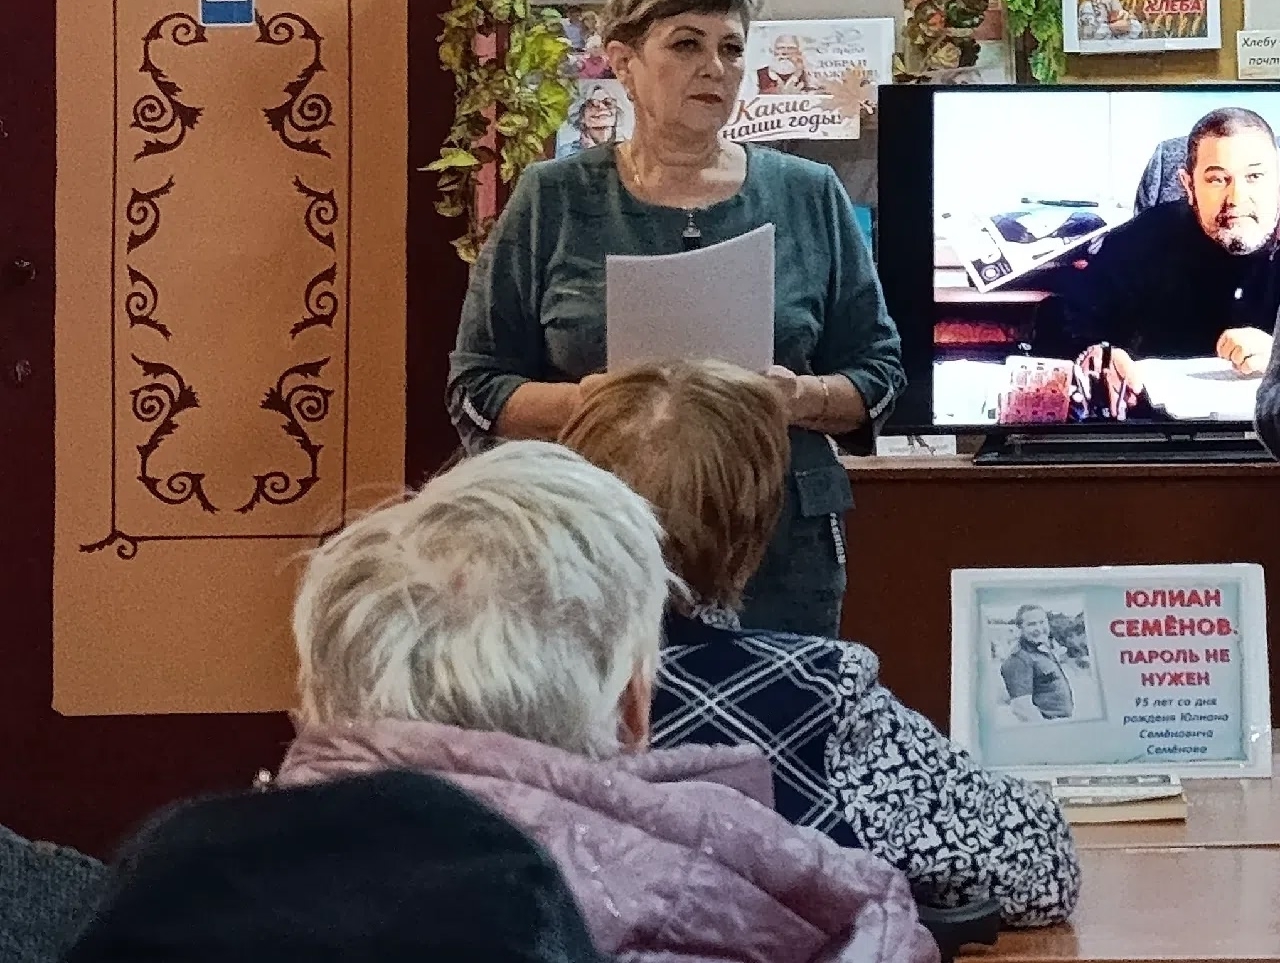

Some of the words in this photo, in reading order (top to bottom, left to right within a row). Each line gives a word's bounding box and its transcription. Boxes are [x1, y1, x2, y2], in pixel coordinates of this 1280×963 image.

[1241, 37, 1278, 48] Хлебу
[733, 96, 811, 126] Какие
[722, 119, 783, 140] наши
[1126, 589, 1221, 608] ЮЛИАН
[1110, 614, 1238, 637] СЕМЁНОВ.
[1120, 649, 1200, 664] ПАРОЛЬ
[1205, 648, 1230, 663] НЕ
[1141, 672, 1211, 687] НУЖЕН
[1135, 697, 1149, 707] 95
[1153, 698, 1173, 707] лет
[1177, 698, 1191, 707] со
[1194, 698, 1217, 707] дня
